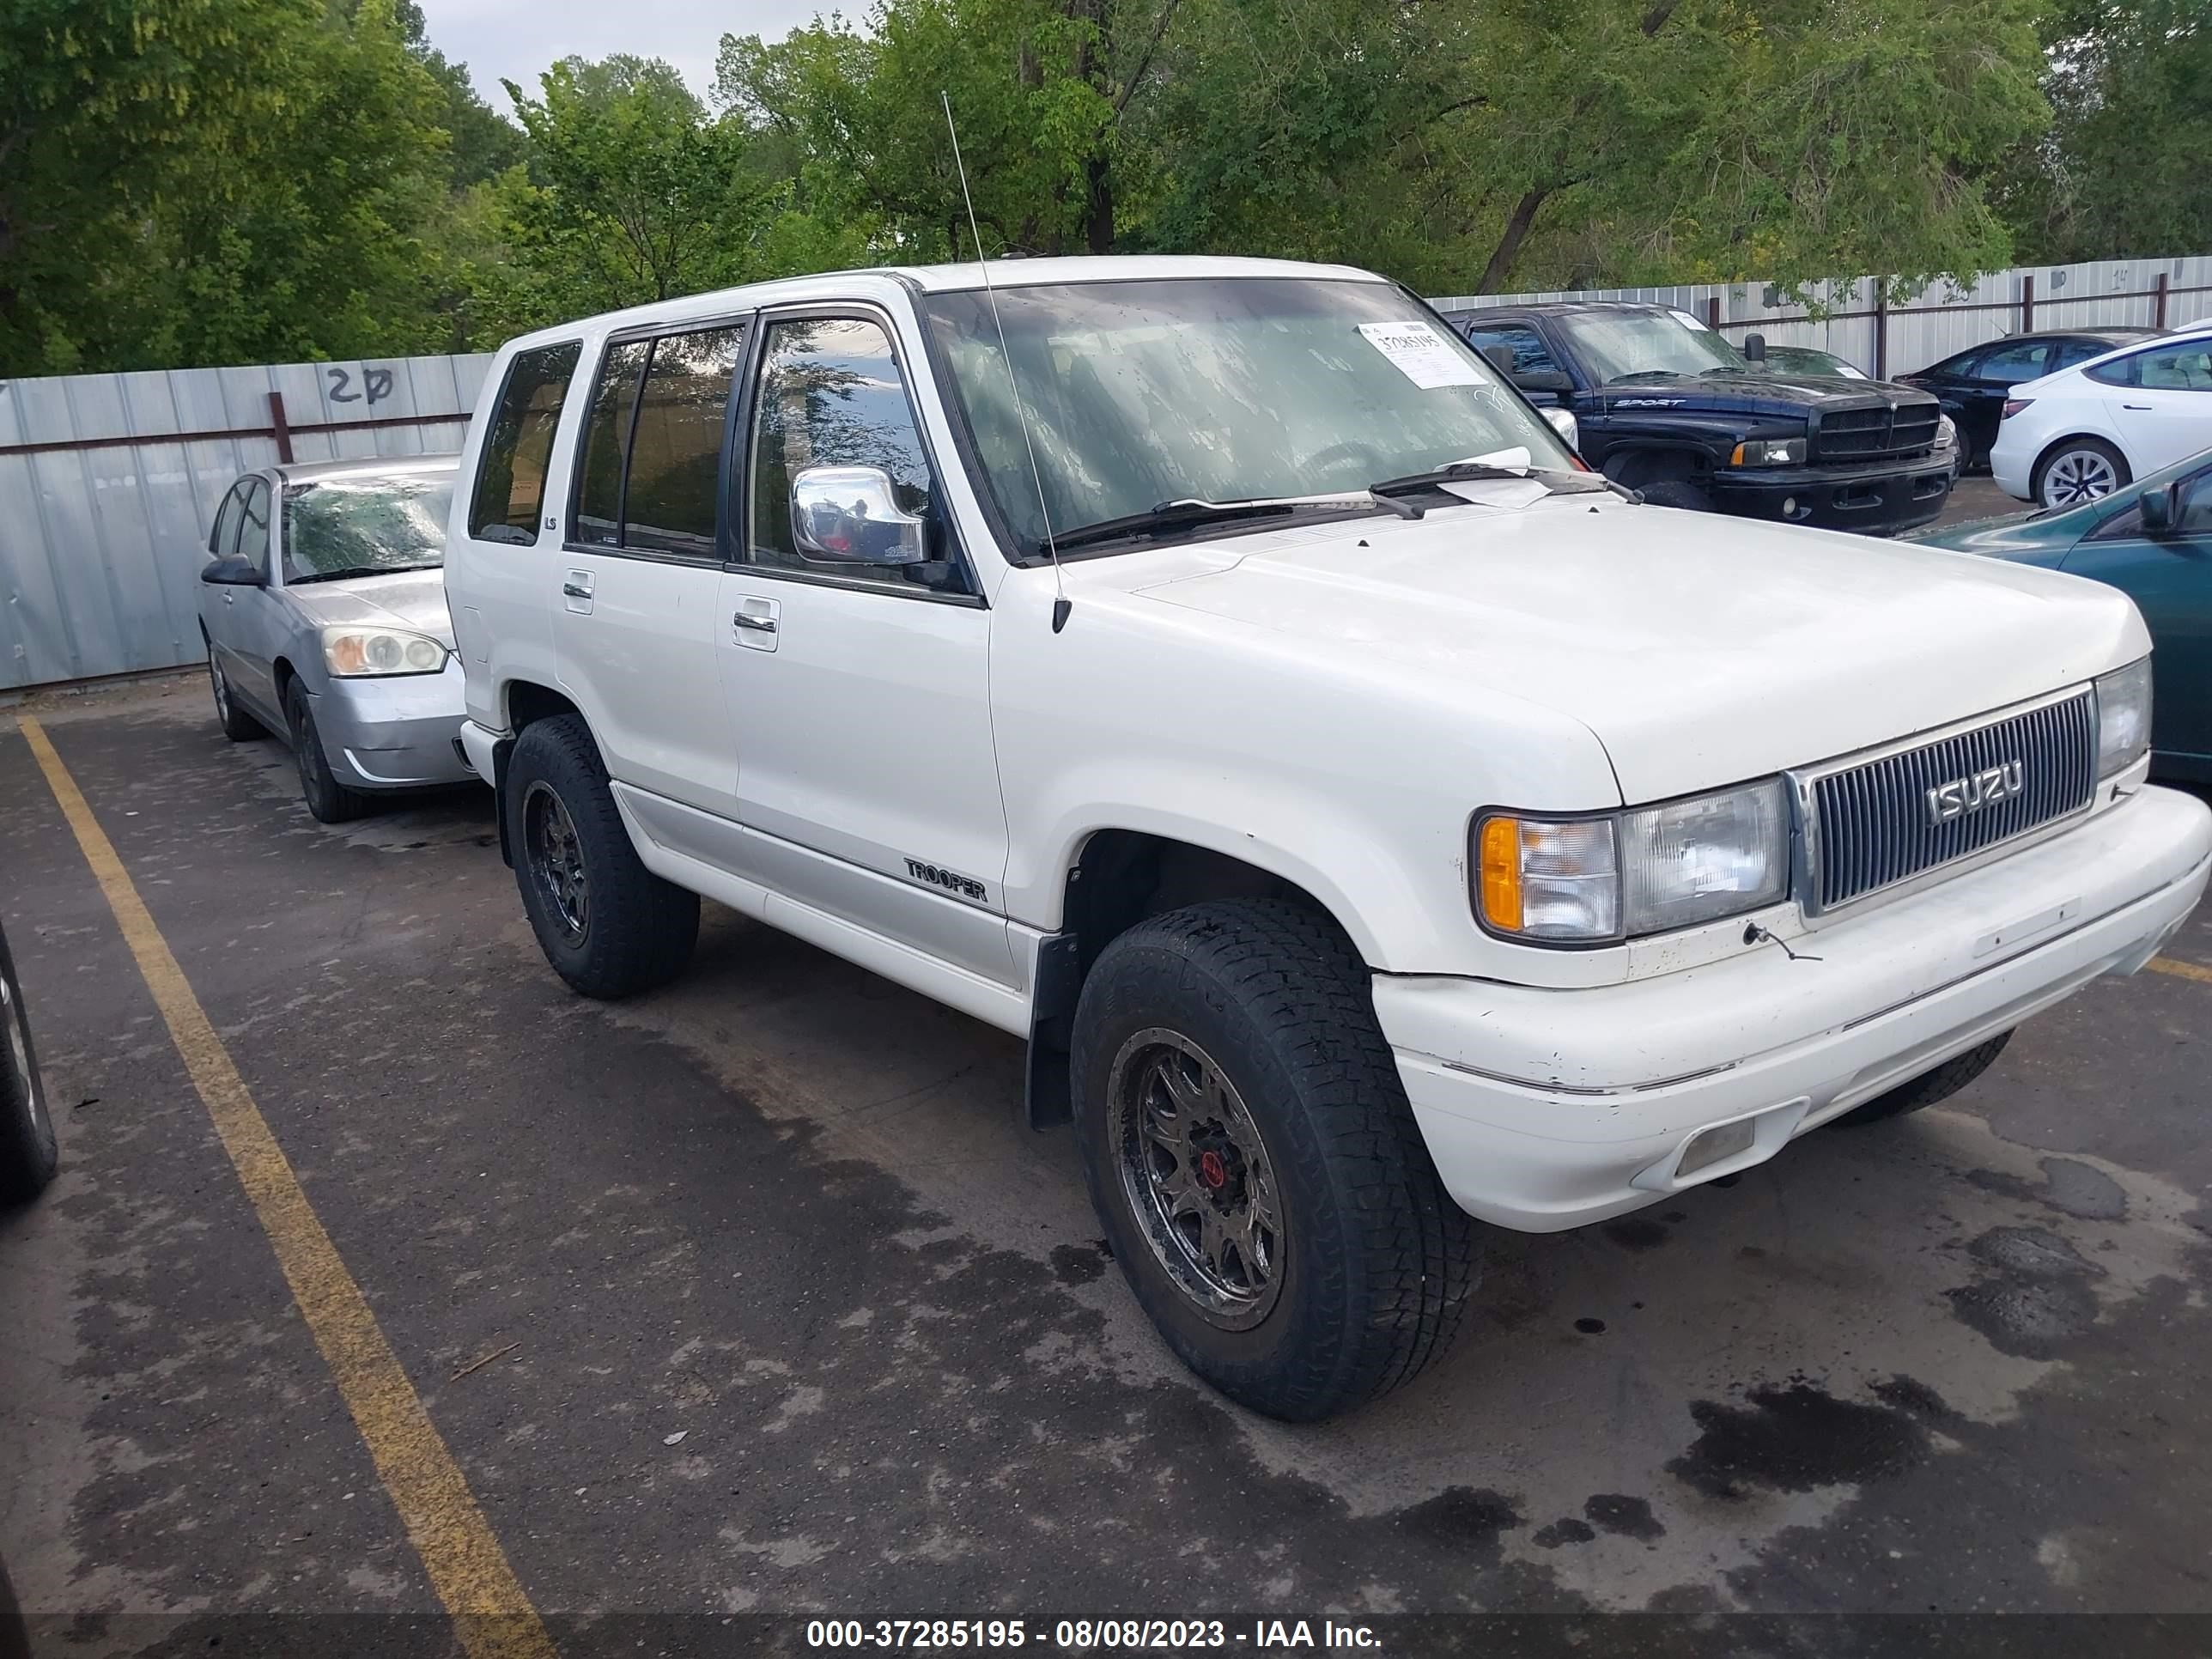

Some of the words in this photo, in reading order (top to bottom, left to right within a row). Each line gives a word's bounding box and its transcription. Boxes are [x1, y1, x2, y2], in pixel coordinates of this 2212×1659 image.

[544, 517, 556, 530] LS
[1926, 759, 2023, 827] ISUZU
[903, 857, 988, 902] TROOPER
